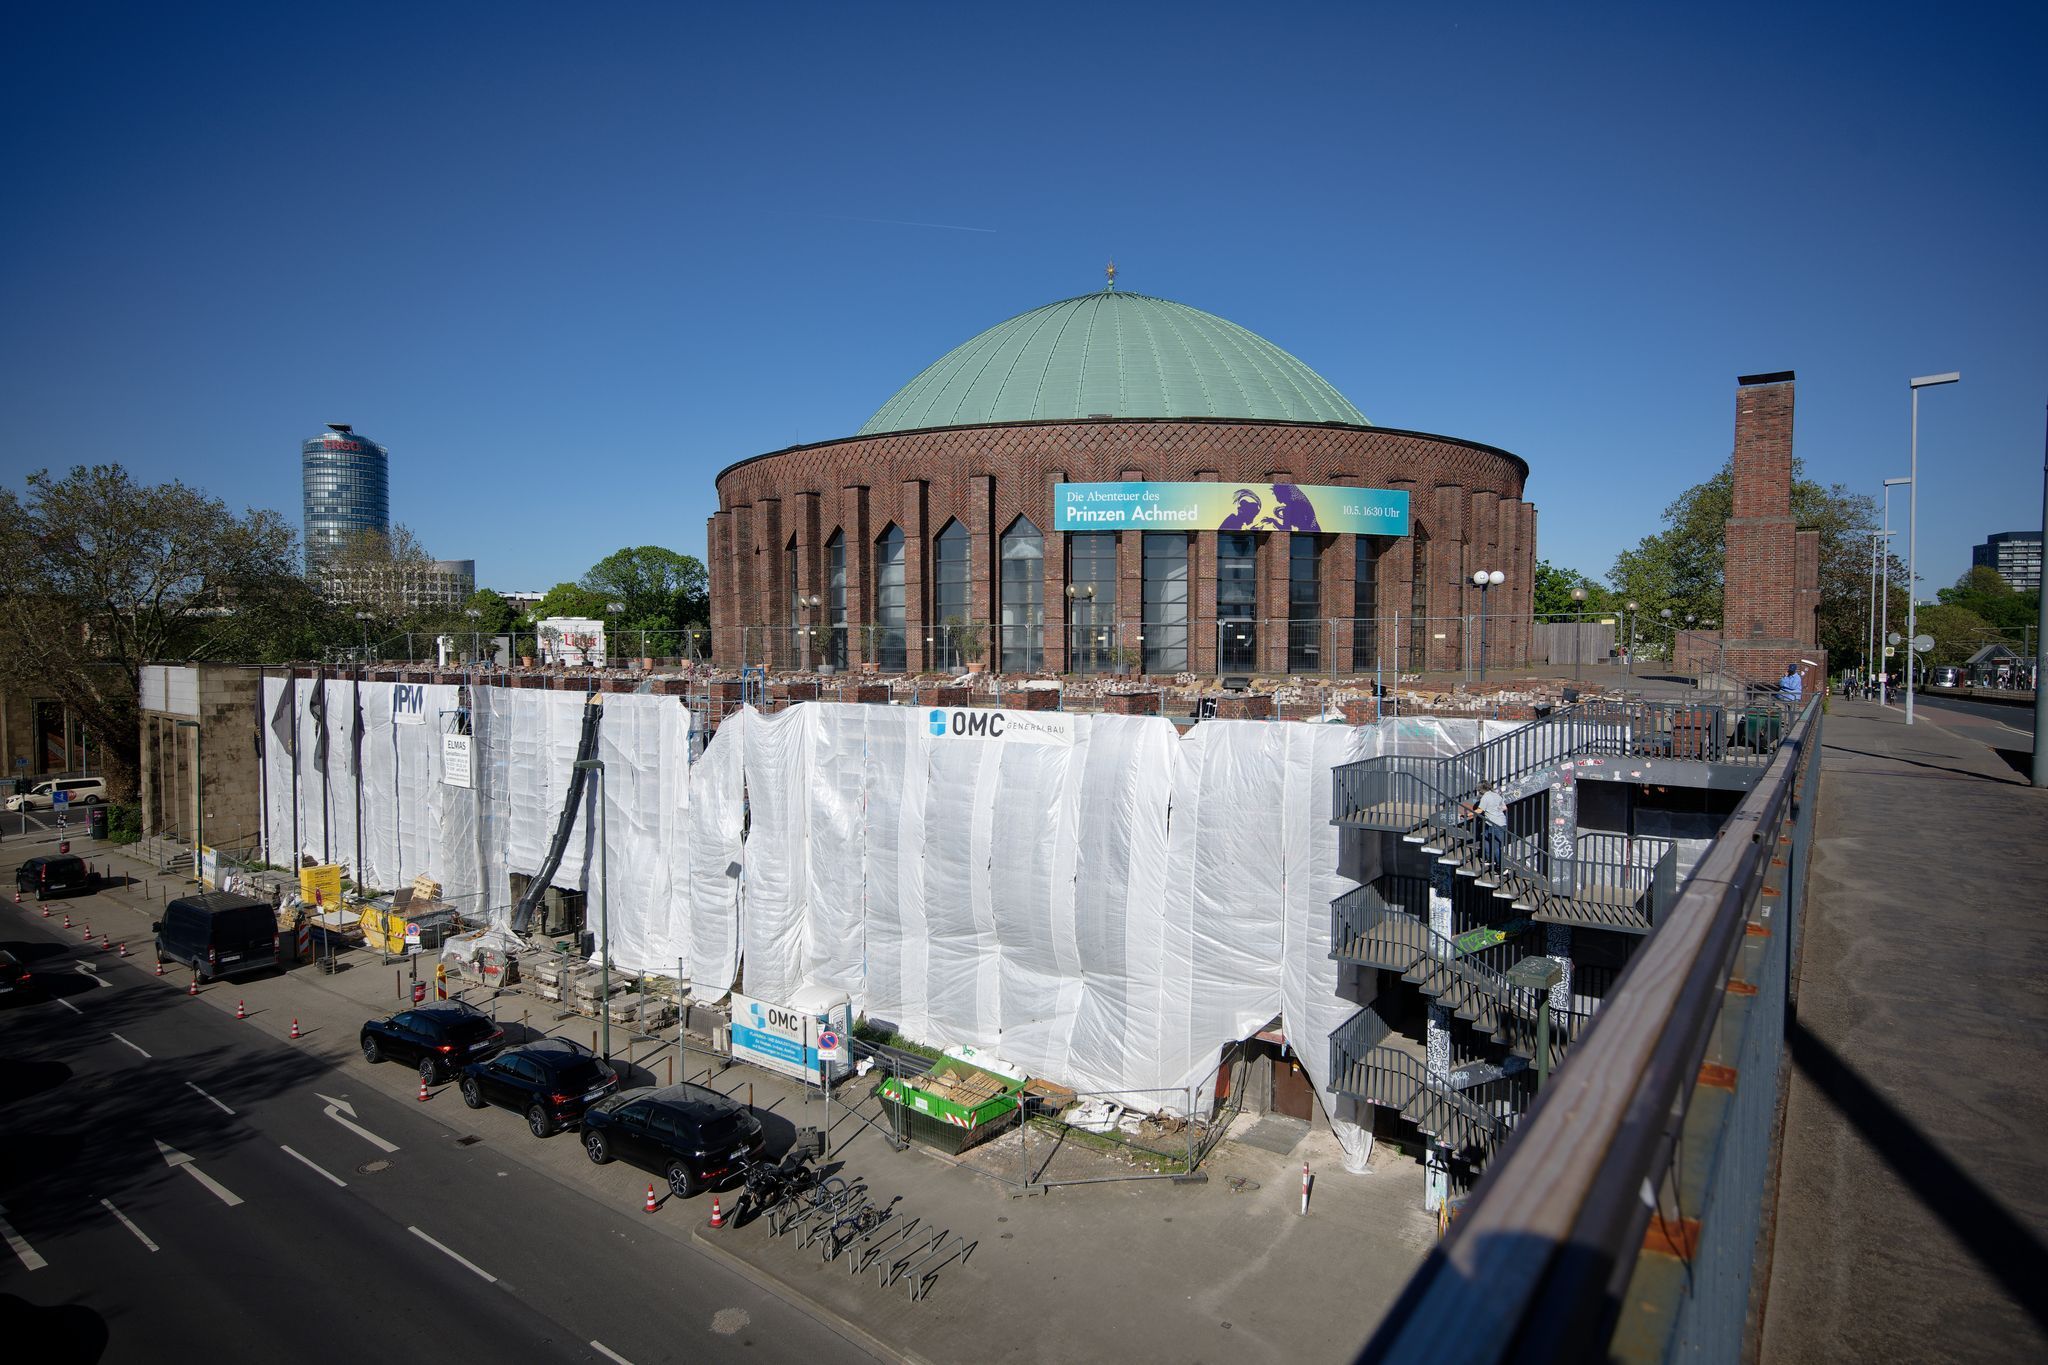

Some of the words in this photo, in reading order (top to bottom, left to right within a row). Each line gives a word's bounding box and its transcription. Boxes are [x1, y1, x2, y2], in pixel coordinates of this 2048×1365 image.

[324, 439, 361, 451] ERGO
[1067, 492, 1084, 502] Die
[1087, 491, 1139, 502] Abenteuer
[1142, 490, 1160, 501] des
[1066, 506, 1125, 522] Prinzen
[1131, 504, 1198, 521] Achmed
[1343, 505, 1361, 515] 10.5.
[1364, 506, 1383, 516] 16:30
[1384, 507, 1400, 517] Uhr
[393, 684, 424, 714] IPM
[952, 711, 1005, 738] OMC
[1006, 721, 1065, 734] GENERALBAU
[447, 740, 467, 750] ELMAS
[768, 1008, 798, 1032] OMC
